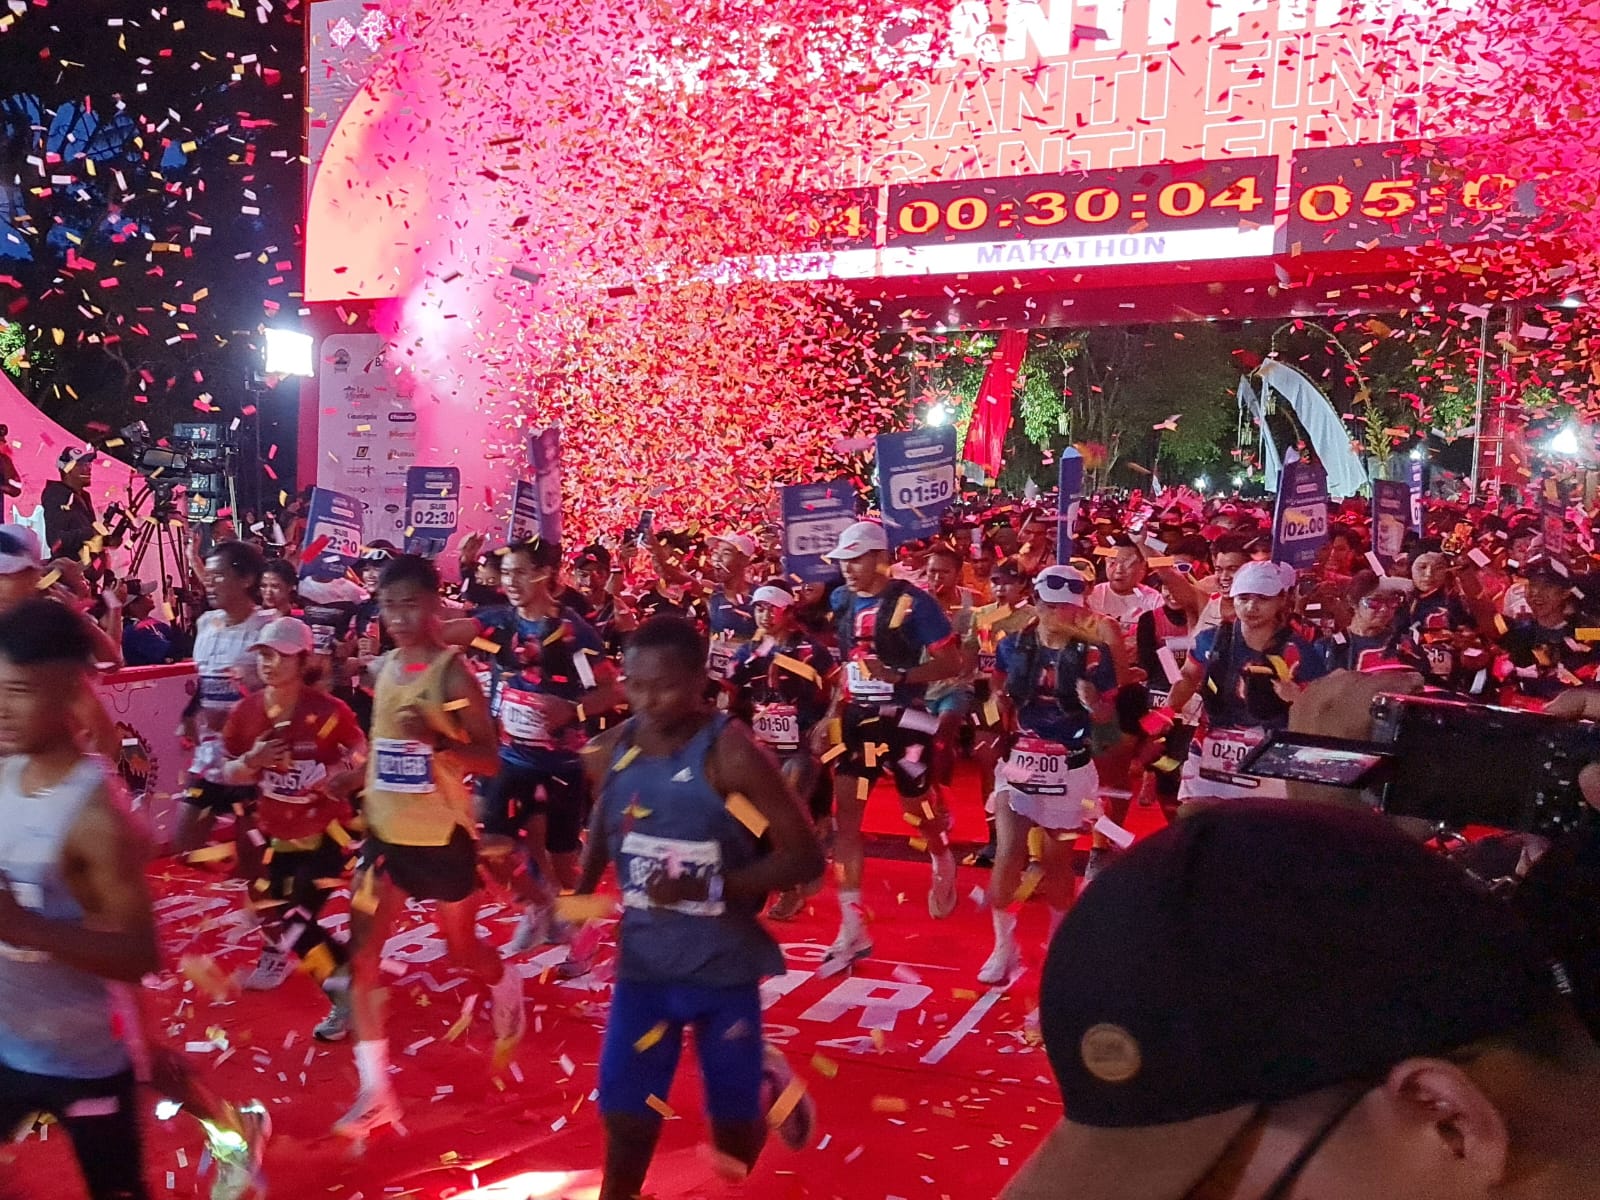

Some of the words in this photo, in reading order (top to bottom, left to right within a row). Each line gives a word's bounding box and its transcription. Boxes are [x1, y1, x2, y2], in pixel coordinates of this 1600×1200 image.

[899, 176, 1263, 233] 00:30:04
[977, 236, 1165, 264] MARATHON
[900, 480, 948, 504] 01:50
[415, 511, 454, 525] 02:30
[759, 716, 790, 732] 01:50
[1212, 742, 1246, 761] 02:0
[1016, 754, 1058, 773] 02:00
